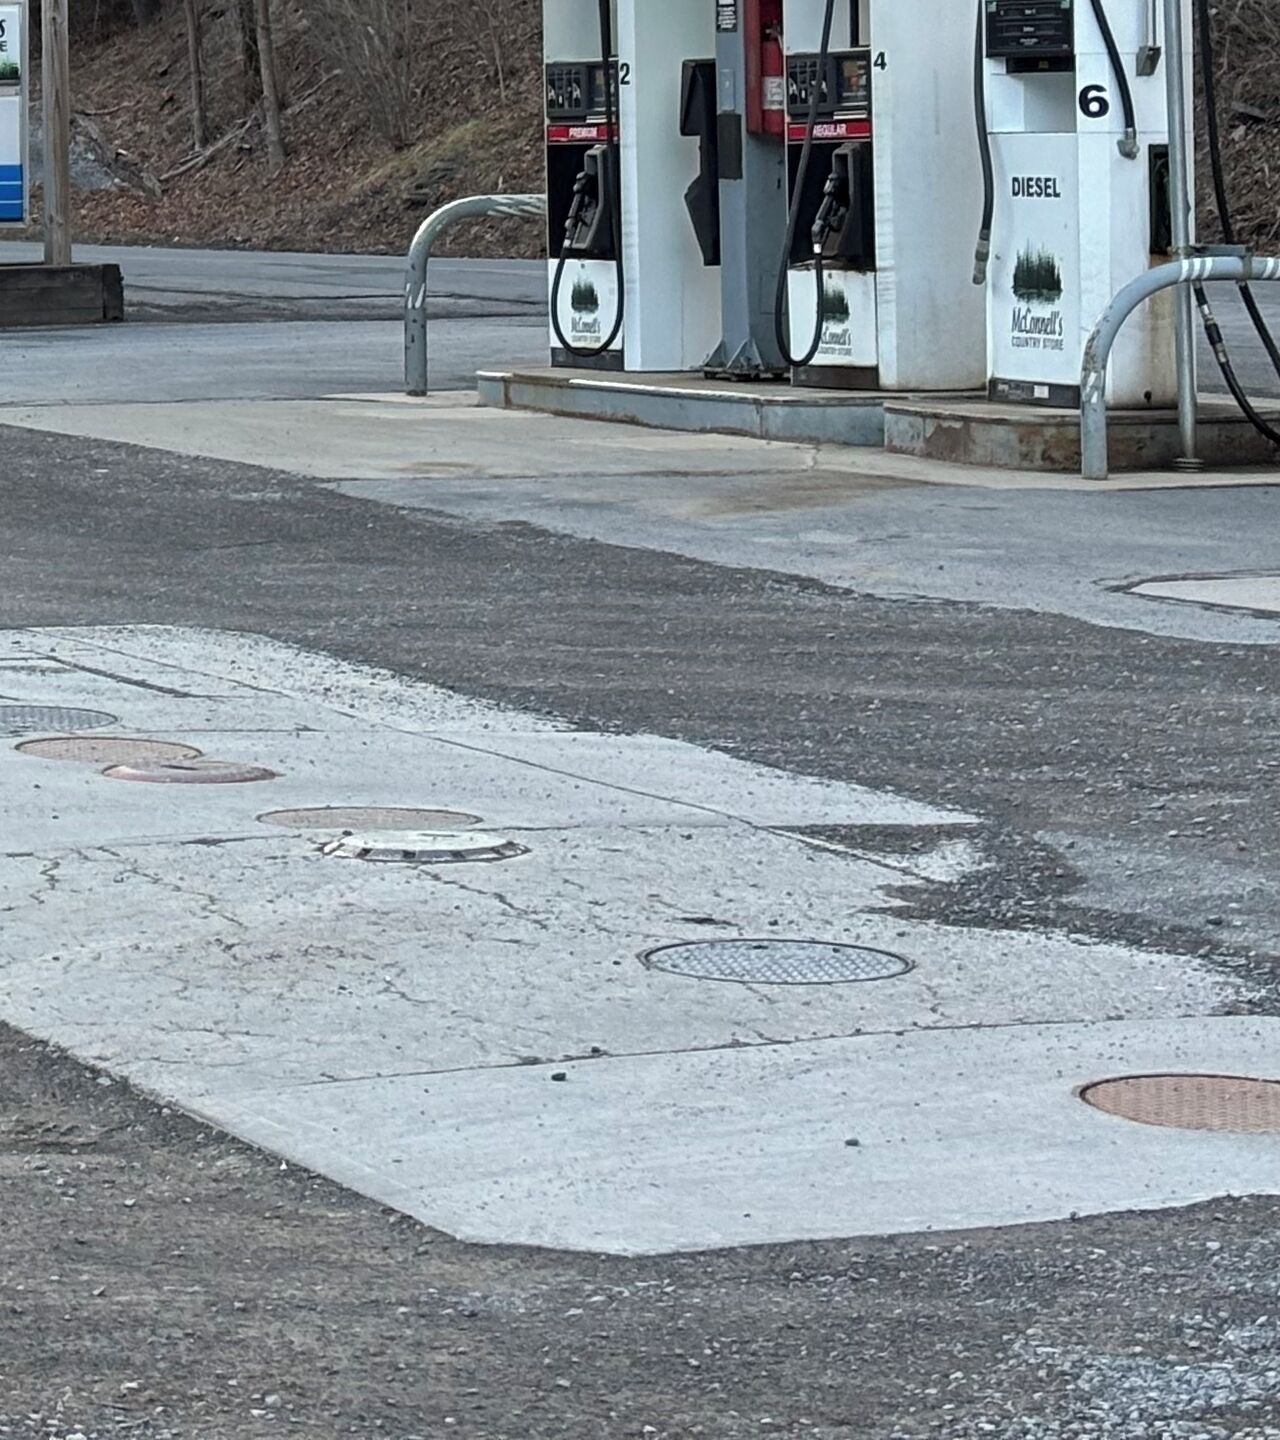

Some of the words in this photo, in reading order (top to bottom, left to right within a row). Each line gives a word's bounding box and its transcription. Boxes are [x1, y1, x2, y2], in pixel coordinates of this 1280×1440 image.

[873, 51, 887, 71] 4
[620, 62, 631, 86] 2
[1078, 84, 1110, 119] 6
[813, 123, 847, 137] REGULAR
[1011, 176, 1061, 198] DIESEL
[1012, 306, 1063, 336] McConnell's
[1011, 336, 1041, 349] COUNTRY
[1043, 337, 1064, 351] STORE
